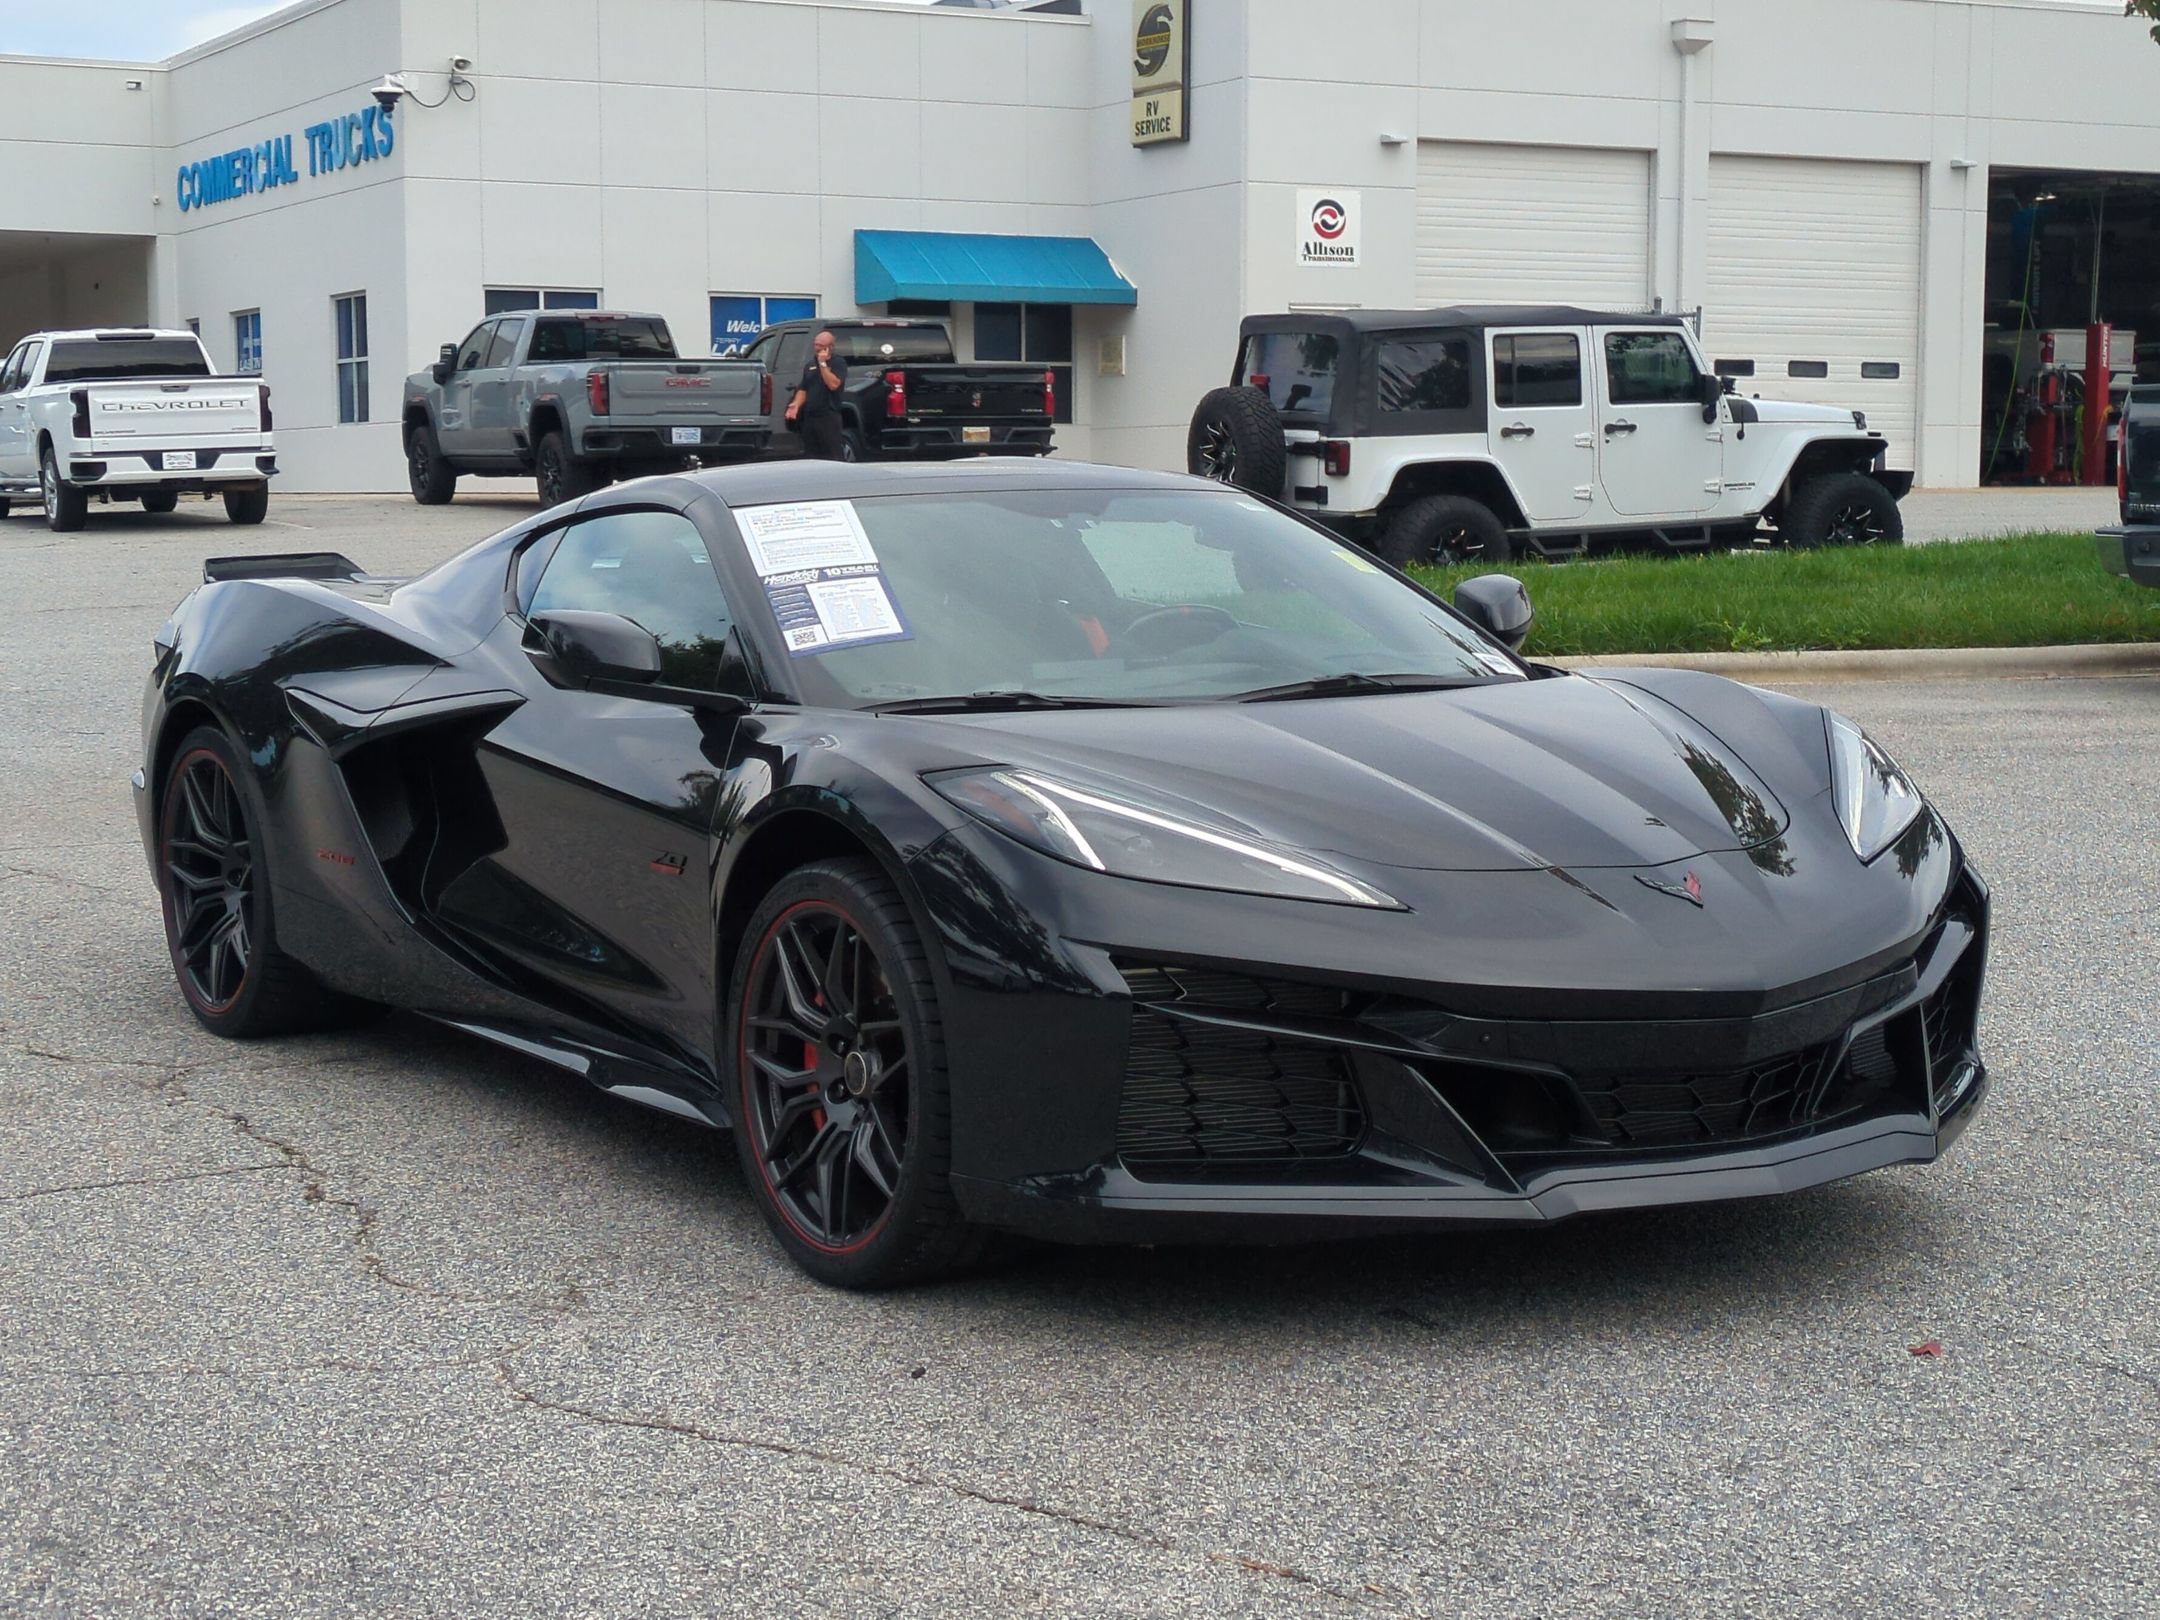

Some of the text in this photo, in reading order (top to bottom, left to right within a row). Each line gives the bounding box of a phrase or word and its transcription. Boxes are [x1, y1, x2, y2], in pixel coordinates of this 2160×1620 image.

[1146, 101, 1159, 117] RV
[1135, 116, 1171, 137] SERVICE
[177, 105, 394, 212] COMMERCIAL TRUCKS
[1302, 241, 1354, 256] Allison
[1302, 253, 1355, 263] Transmission
[102, 399, 249, 412] CHEVROLET
